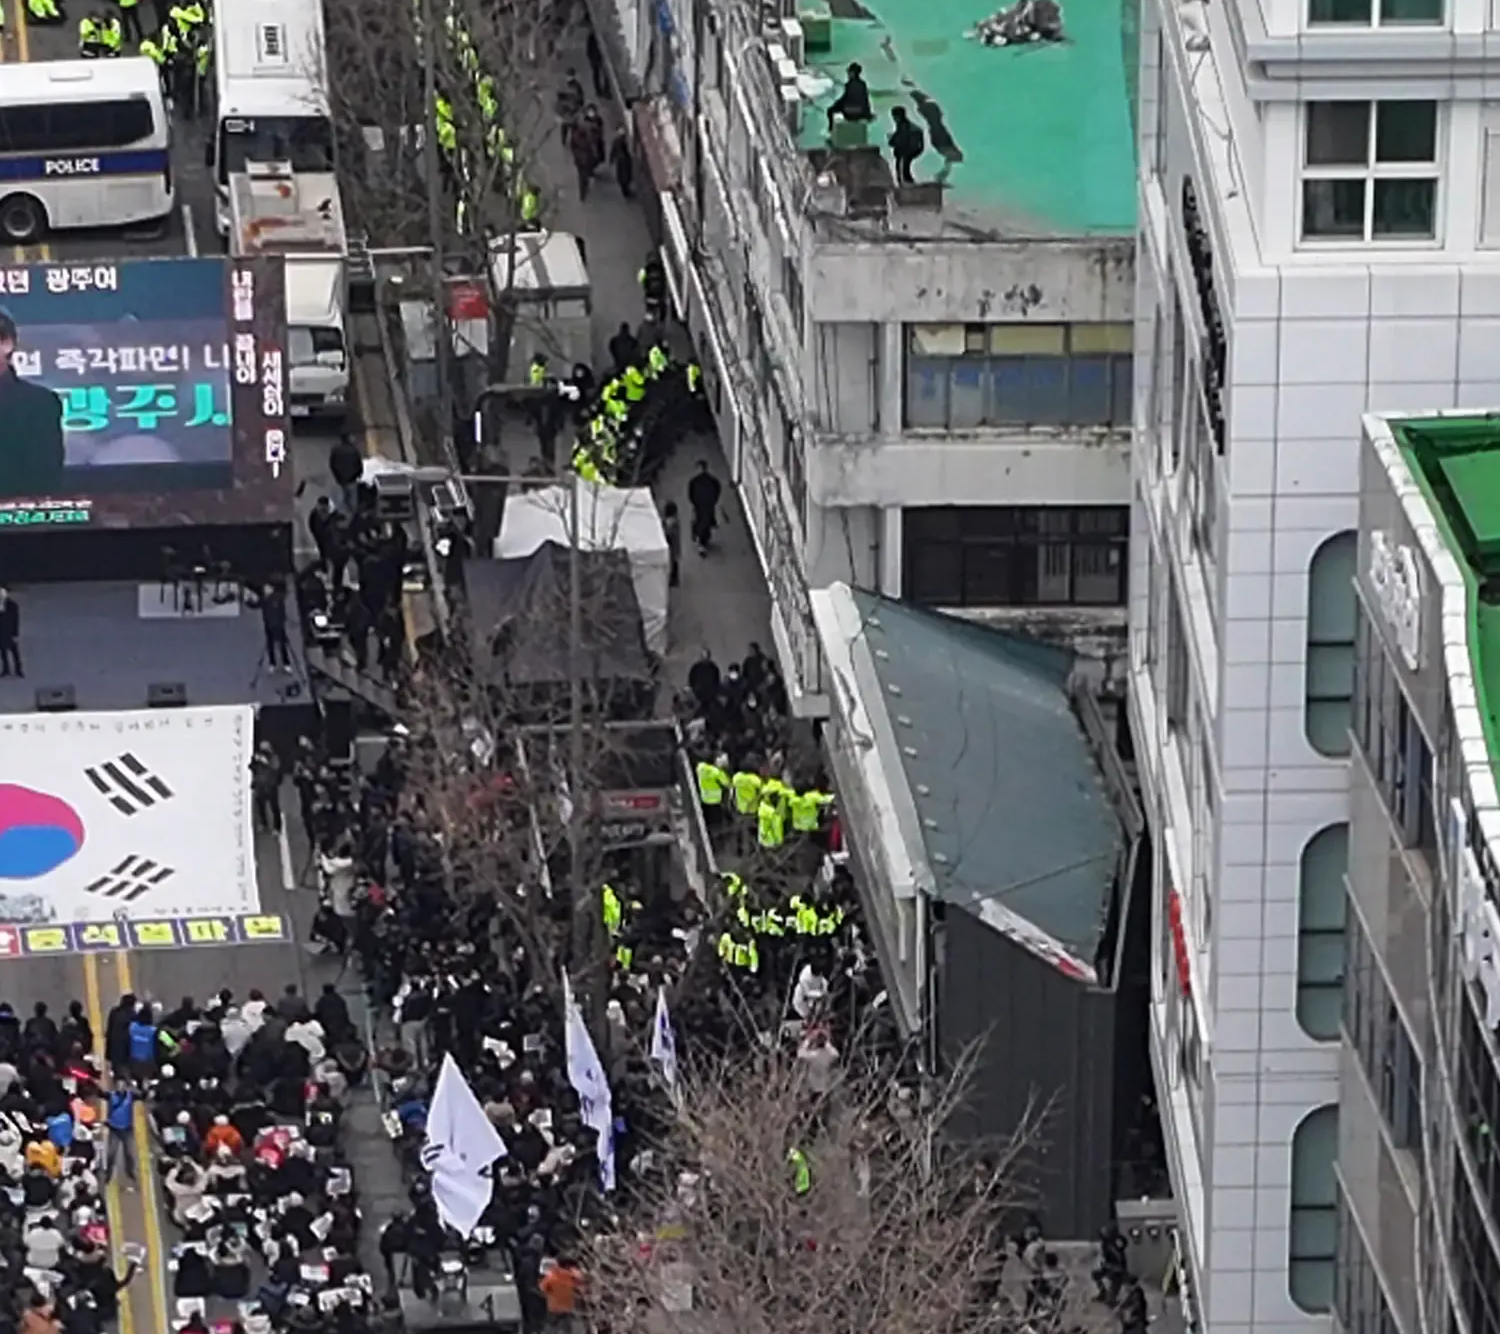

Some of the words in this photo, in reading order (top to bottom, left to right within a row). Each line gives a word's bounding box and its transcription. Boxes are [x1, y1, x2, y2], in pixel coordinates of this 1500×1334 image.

[46, 157, 100, 175] POLICE
[45, 266, 117, 292] 광주여
[55, 347, 190, 374] 즉각파면!
[27, 914, 282, 952] 윤석열파면
